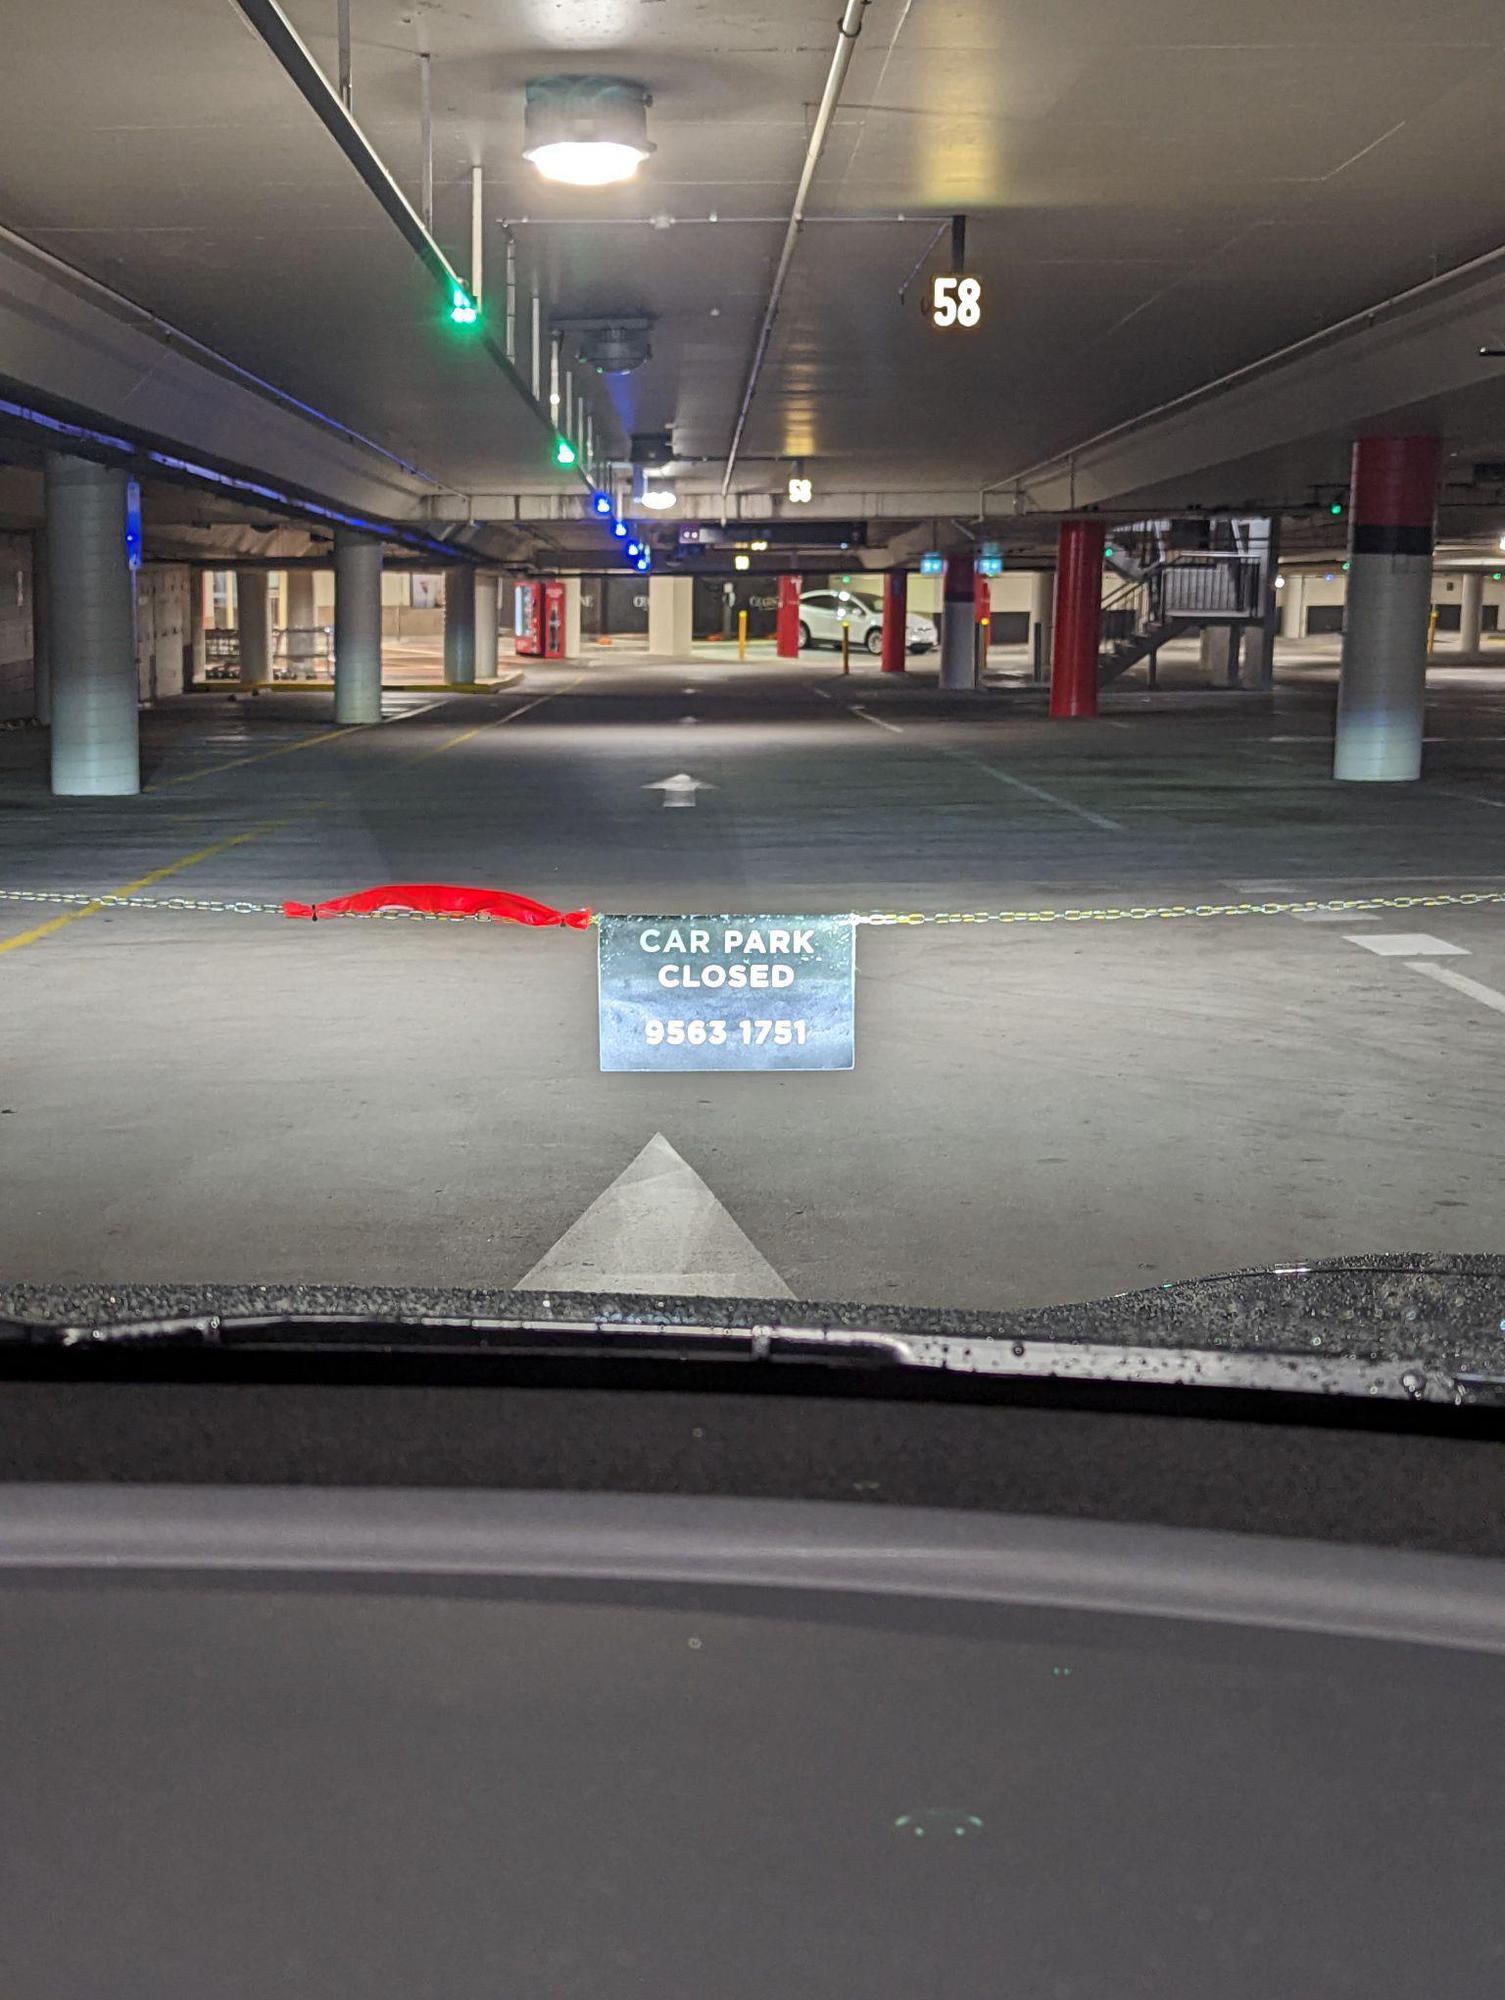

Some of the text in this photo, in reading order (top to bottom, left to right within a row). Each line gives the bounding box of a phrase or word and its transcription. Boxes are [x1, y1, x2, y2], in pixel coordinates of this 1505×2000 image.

[933, 277, 981, 327] 58
[639, 929, 815, 954] CAR PARK
[657, 964, 795, 988] CLOSED
[644, 1020, 807, 1045] 9563 1751
